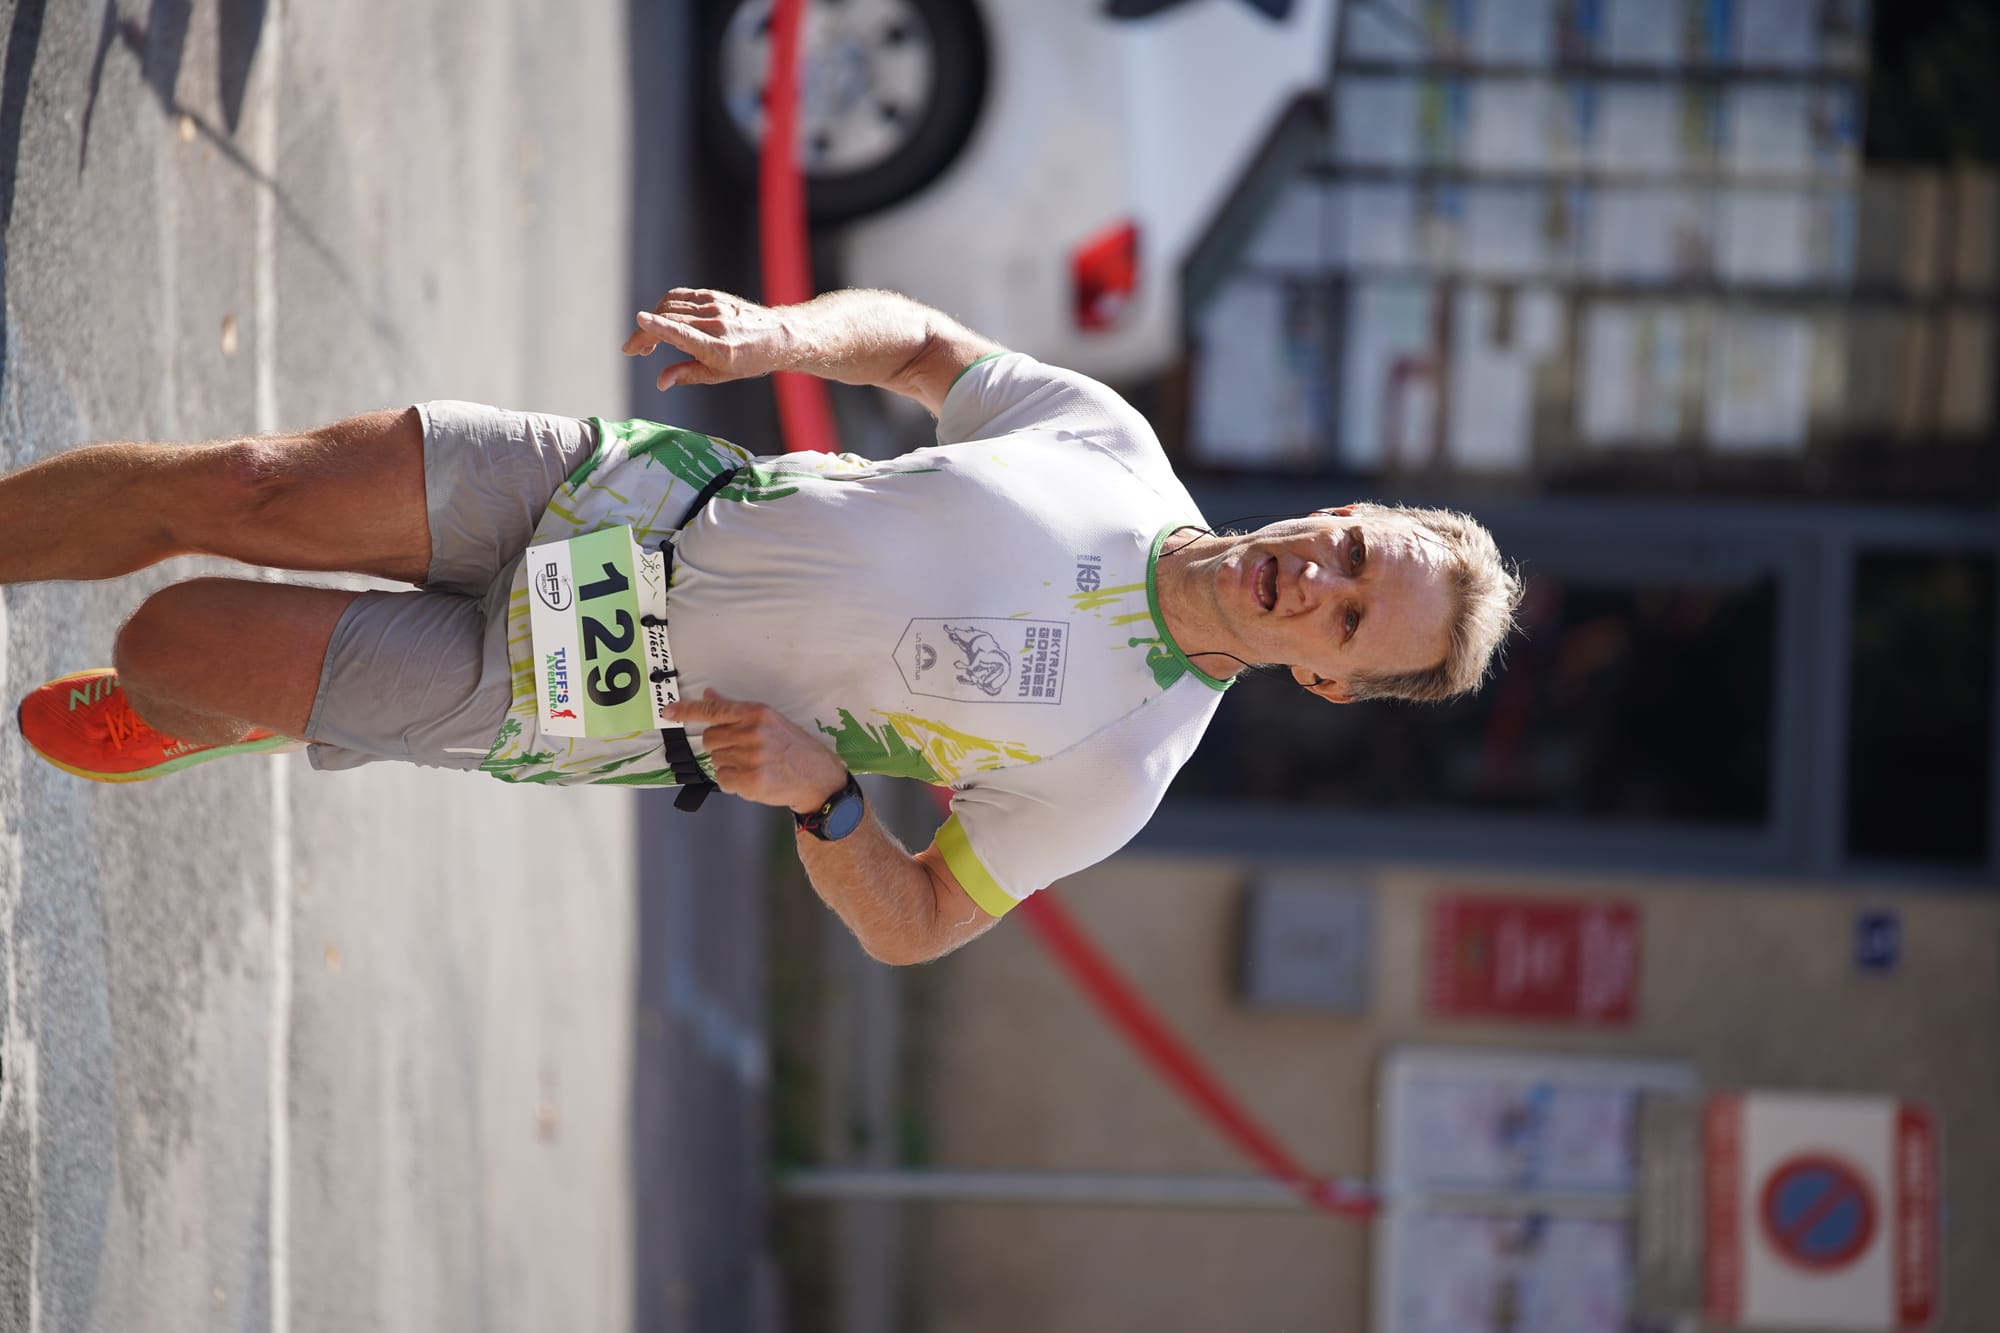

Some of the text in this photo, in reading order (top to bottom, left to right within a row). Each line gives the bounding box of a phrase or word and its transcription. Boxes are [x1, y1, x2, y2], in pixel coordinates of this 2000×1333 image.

[545, 562, 561, 606] BFP
[578, 561, 641, 707] 129
[656, 625, 672, 684] Challene
[1024, 626, 1036, 649] DU
[1031, 627, 1050, 697] GORGES
[1045, 627, 1062, 698] SKYRACE
[69, 675, 121, 711] UN
[546, 654, 558, 709] Aventure
[554, 647, 569, 704] TUFF'S
